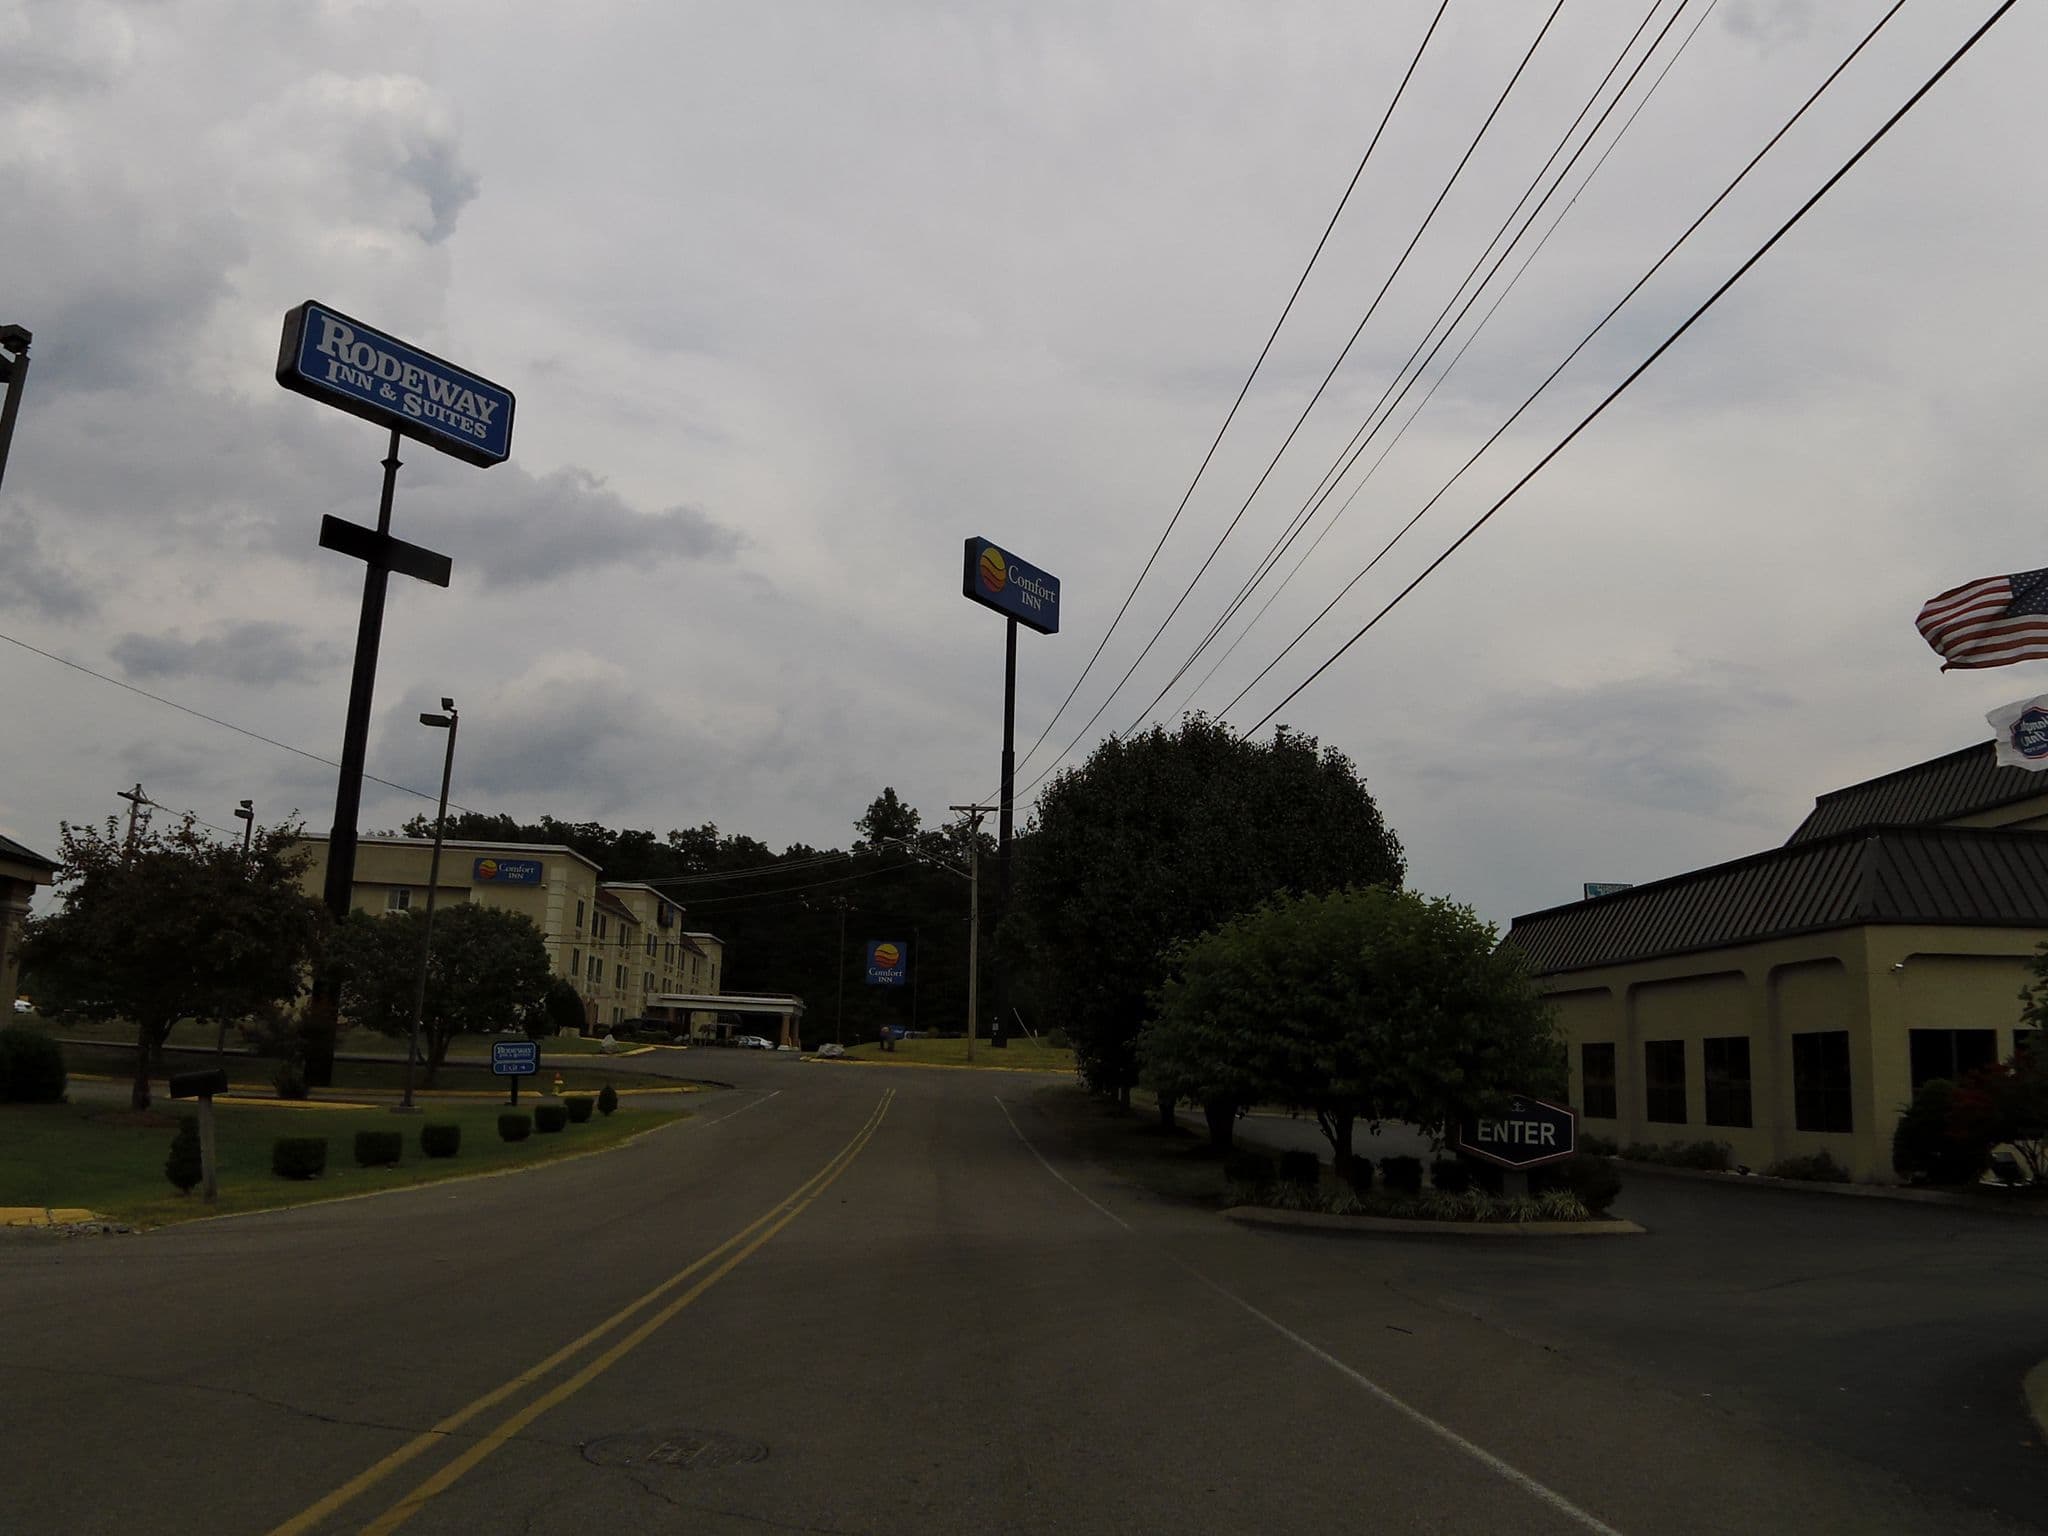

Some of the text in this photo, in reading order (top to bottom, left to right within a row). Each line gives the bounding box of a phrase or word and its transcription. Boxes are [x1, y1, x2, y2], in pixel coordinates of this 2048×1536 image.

[316, 315, 499, 424] RODEWAY
[325, 358, 487, 440] INN & SUITES
[1008, 565, 1056, 603] Comfort
[1021, 590, 1042, 611] INN
[499, 863, 535, 874] Comfort
[508, 872, 524, 880] INN
[868, 967, 903, 977] Comfort
[1476, 1118, 1557, 1147] ENTER
